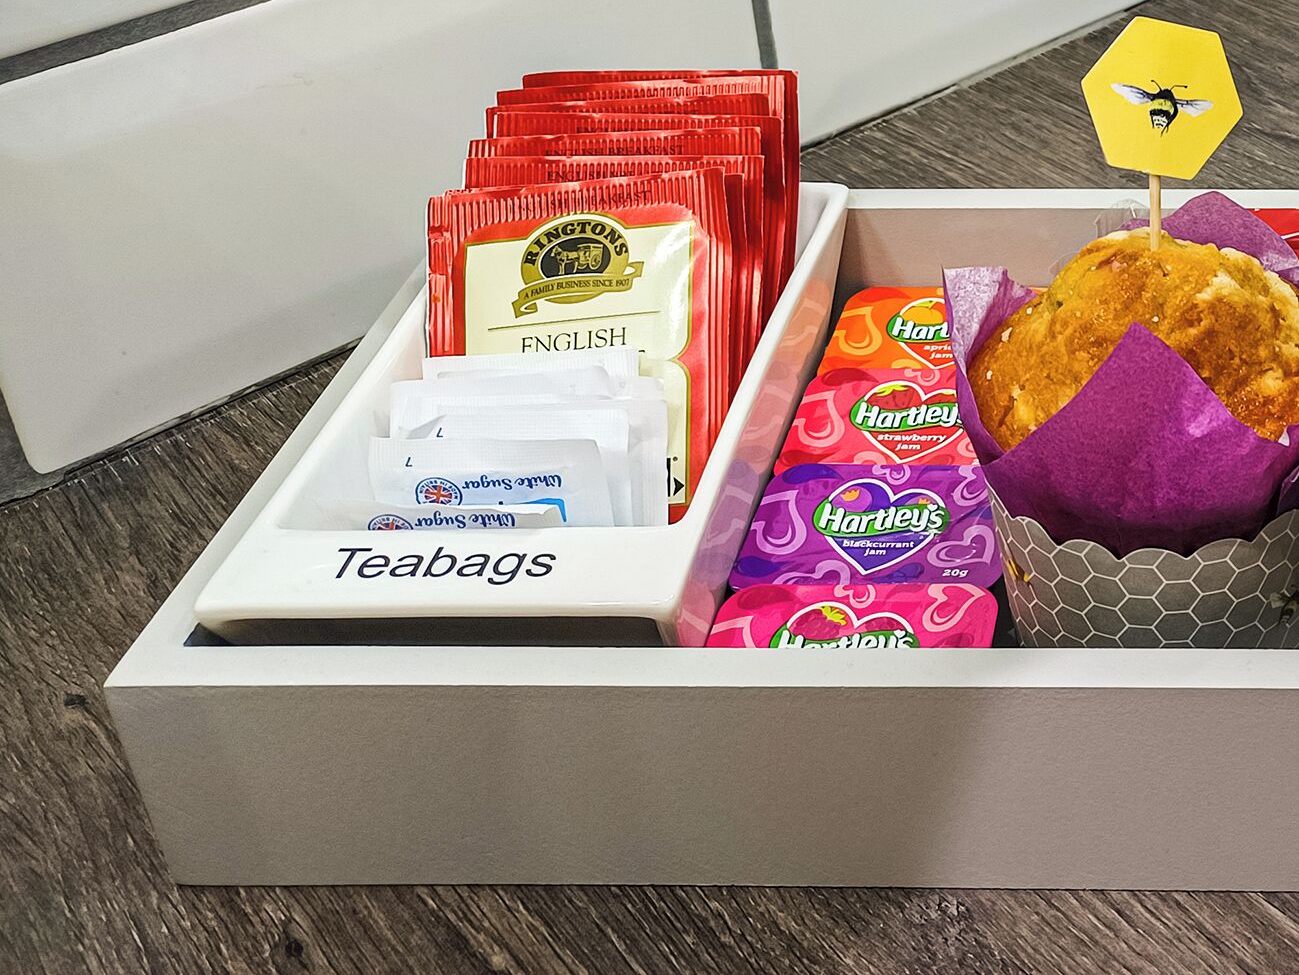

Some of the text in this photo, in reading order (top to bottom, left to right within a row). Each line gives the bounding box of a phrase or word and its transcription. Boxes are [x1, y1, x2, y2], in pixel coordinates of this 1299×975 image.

[523, 221, 629, 267] RINGTONS
[523, 278, 630, 301] A FAMILY BUSINESS SINCE 1907
[521, 326, 627, 354] ENGLISH
[929, 352, 954, 360] jam
[855, 402, 963, 427] Hartley
[876, 433, 947, 443] strawberry
[895, 442, 921, 451] jam
[462, 474, 563, 490] White Sugar
[414, 510, 516, 528] White Sugar
[818, 502, 945, 534] Hartley's
[842, 539, 916, 549] blackcurrant
[863, 547, 887, 557] jam
[335, 546, 557, 586] Teabags
[941, 568, 969, 578] 20g
